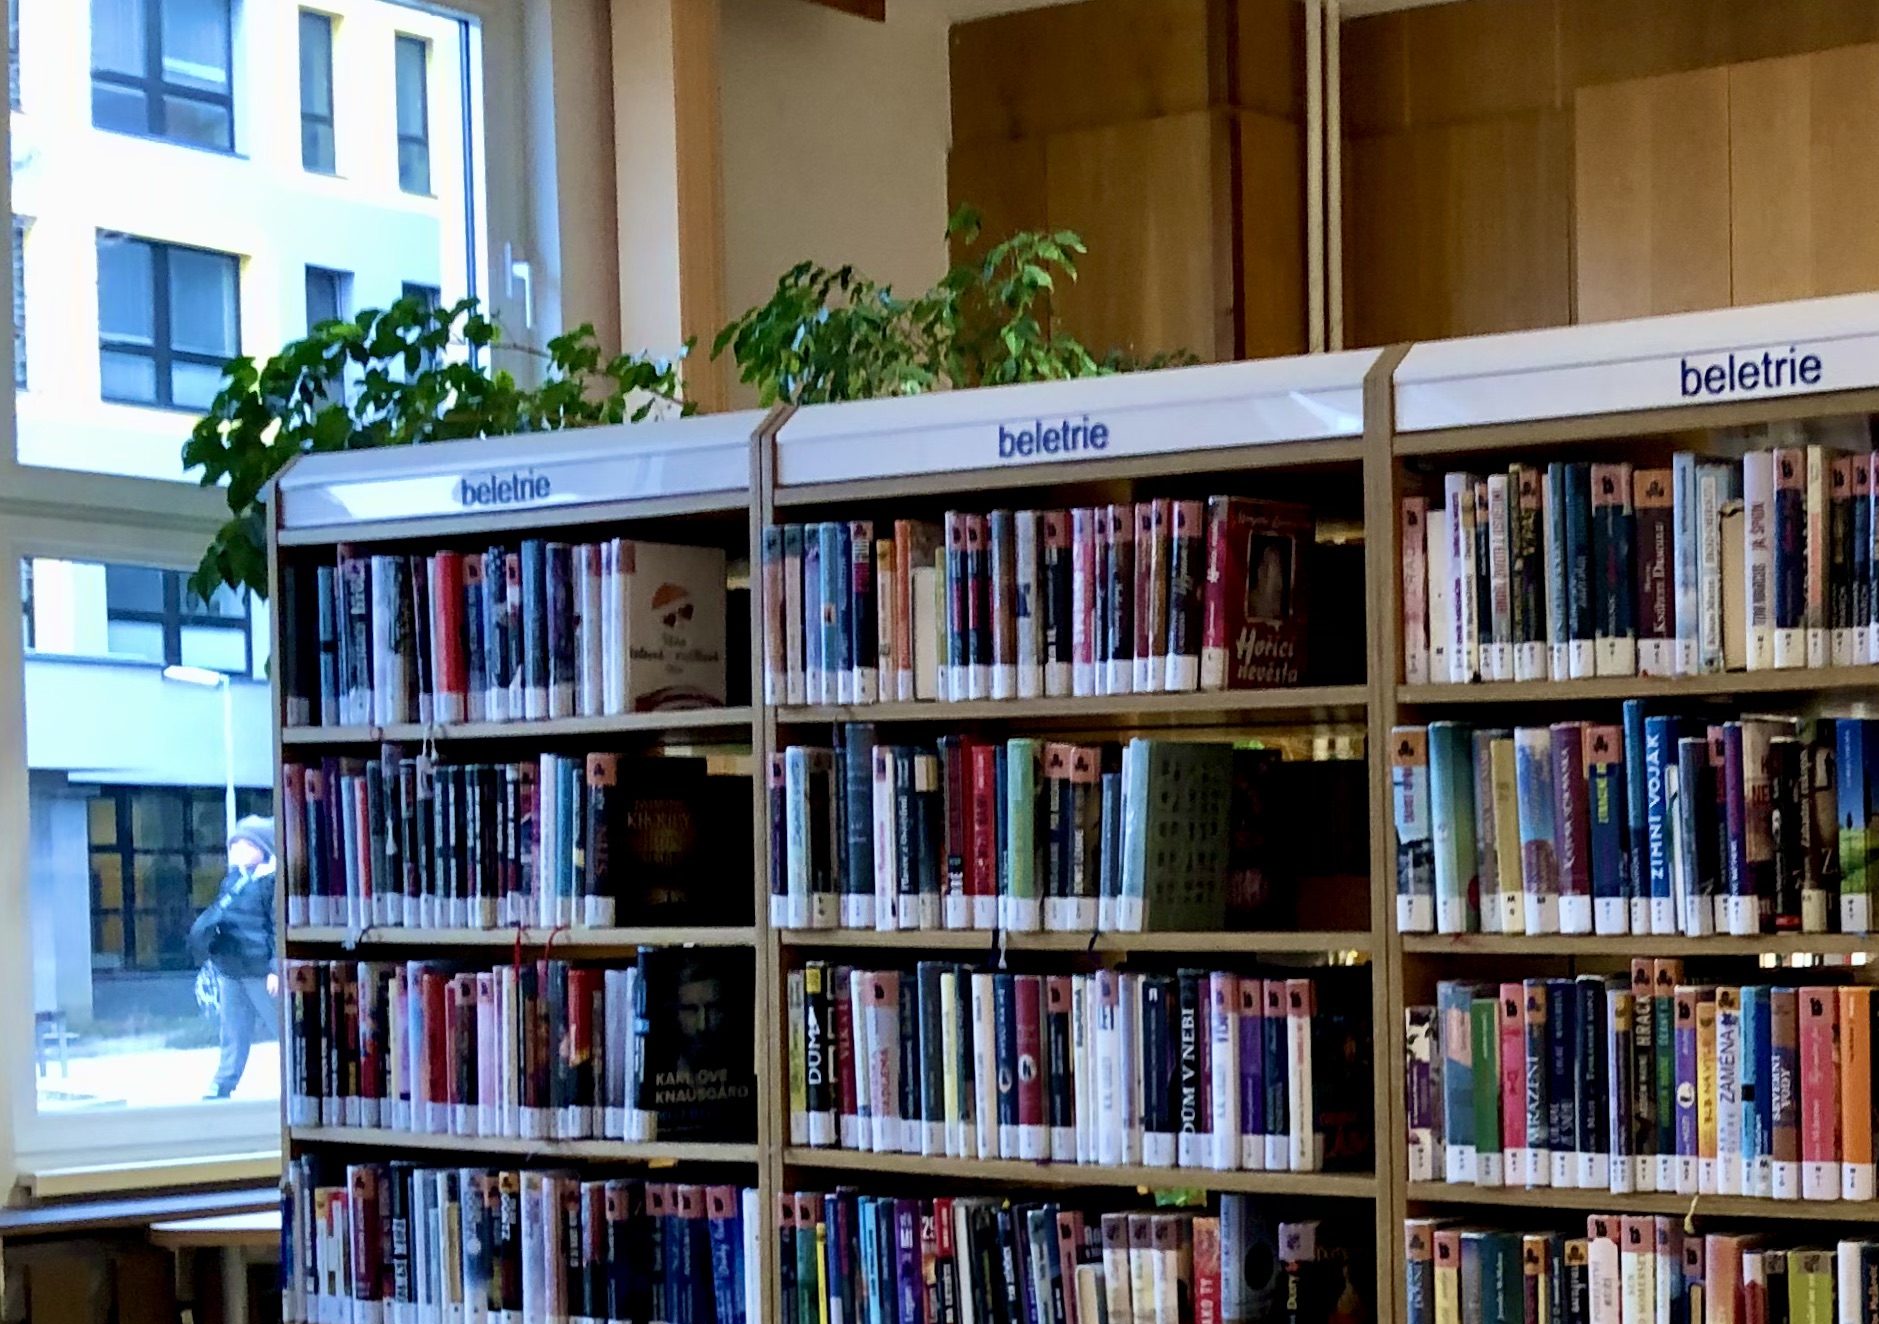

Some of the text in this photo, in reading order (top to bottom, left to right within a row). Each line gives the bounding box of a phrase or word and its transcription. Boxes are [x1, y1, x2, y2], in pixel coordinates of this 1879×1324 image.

[1681, 346, 1823, 397] beletrie
[999, 414, 1109, 458] beletrie
[460, 468, 550, 507] beletrie
[1235, 629, 1294, 660] Hořící
[1237, 661, 1298, 685] nevěsta
[1180, 1007, 1196, 1061] NEBI
[656, 1068, 729, 1087] KARL OVE
[1180, 1064, 1196, 1080] V
[1200, 1277, 1214, 1295] TY
